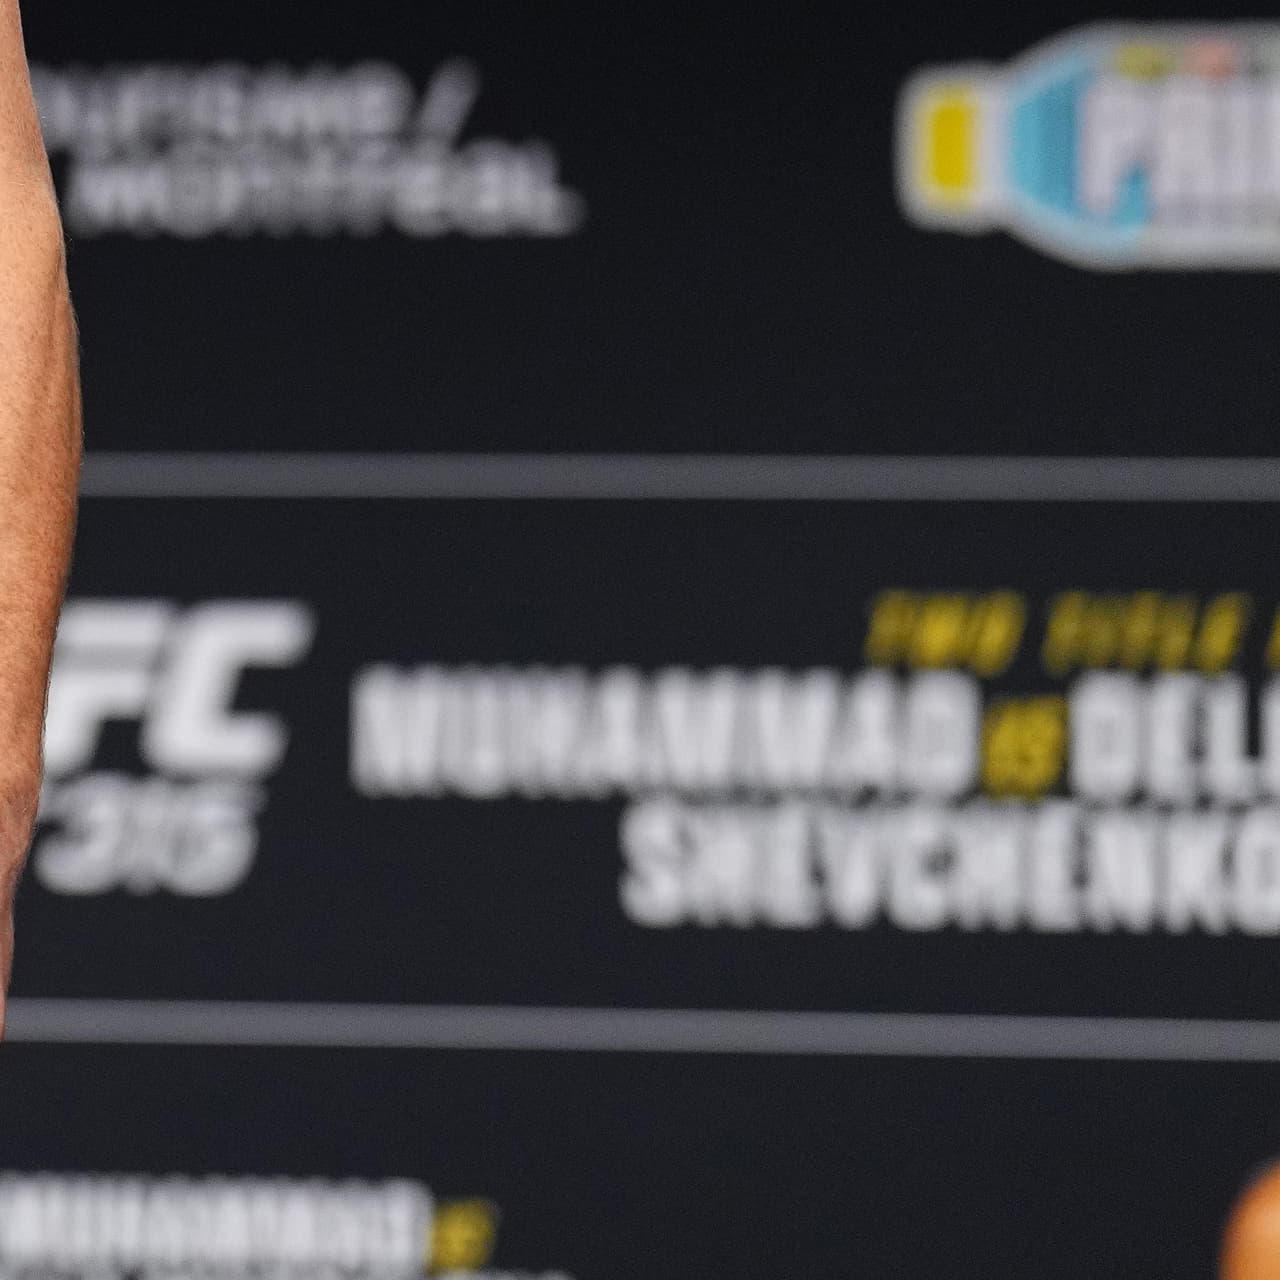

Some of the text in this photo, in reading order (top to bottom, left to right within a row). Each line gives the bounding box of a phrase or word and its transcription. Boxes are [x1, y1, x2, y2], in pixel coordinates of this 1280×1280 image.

[1082, 86, 1280, 230] PRI
[351, 662, 981, 800] MUHAMMAD
[620, 795, 1280, 936] SHEVCHENKO
